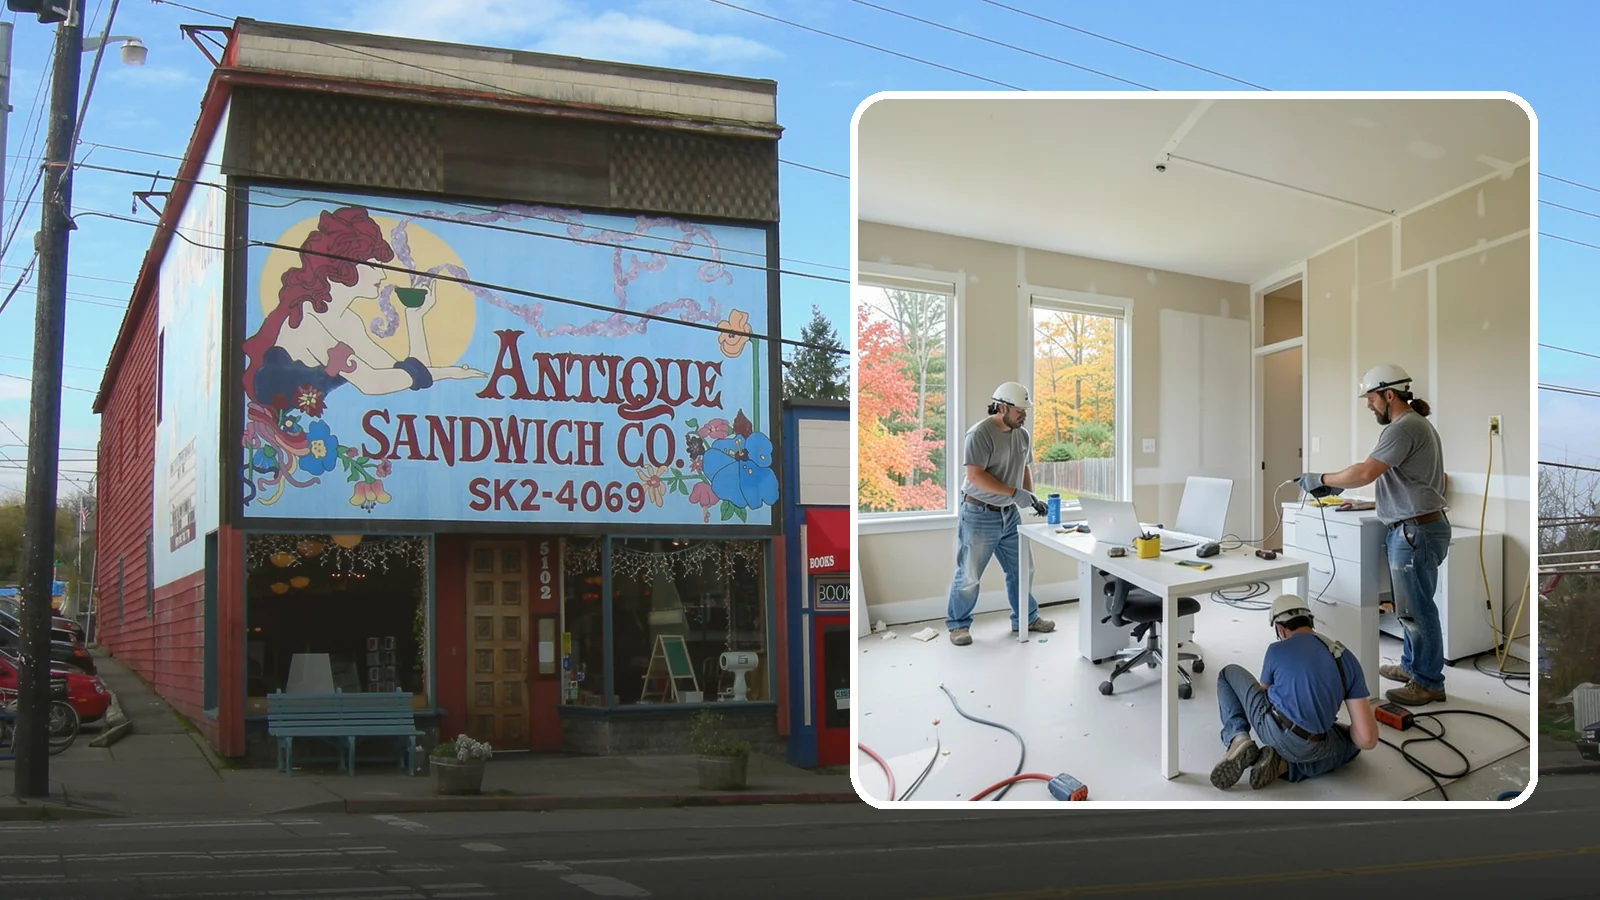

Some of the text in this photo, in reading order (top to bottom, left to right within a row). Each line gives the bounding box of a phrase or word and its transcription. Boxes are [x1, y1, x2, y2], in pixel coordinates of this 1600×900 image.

[475, 329, 723, 421] ANTIQUE
[361, 408, 685, 469] SANDWICH CO.
[468, 477, 645, 513] SK2-4069
[540, 542, 551, 599] 5102
[809, 555, 835, 568] BOOKS
